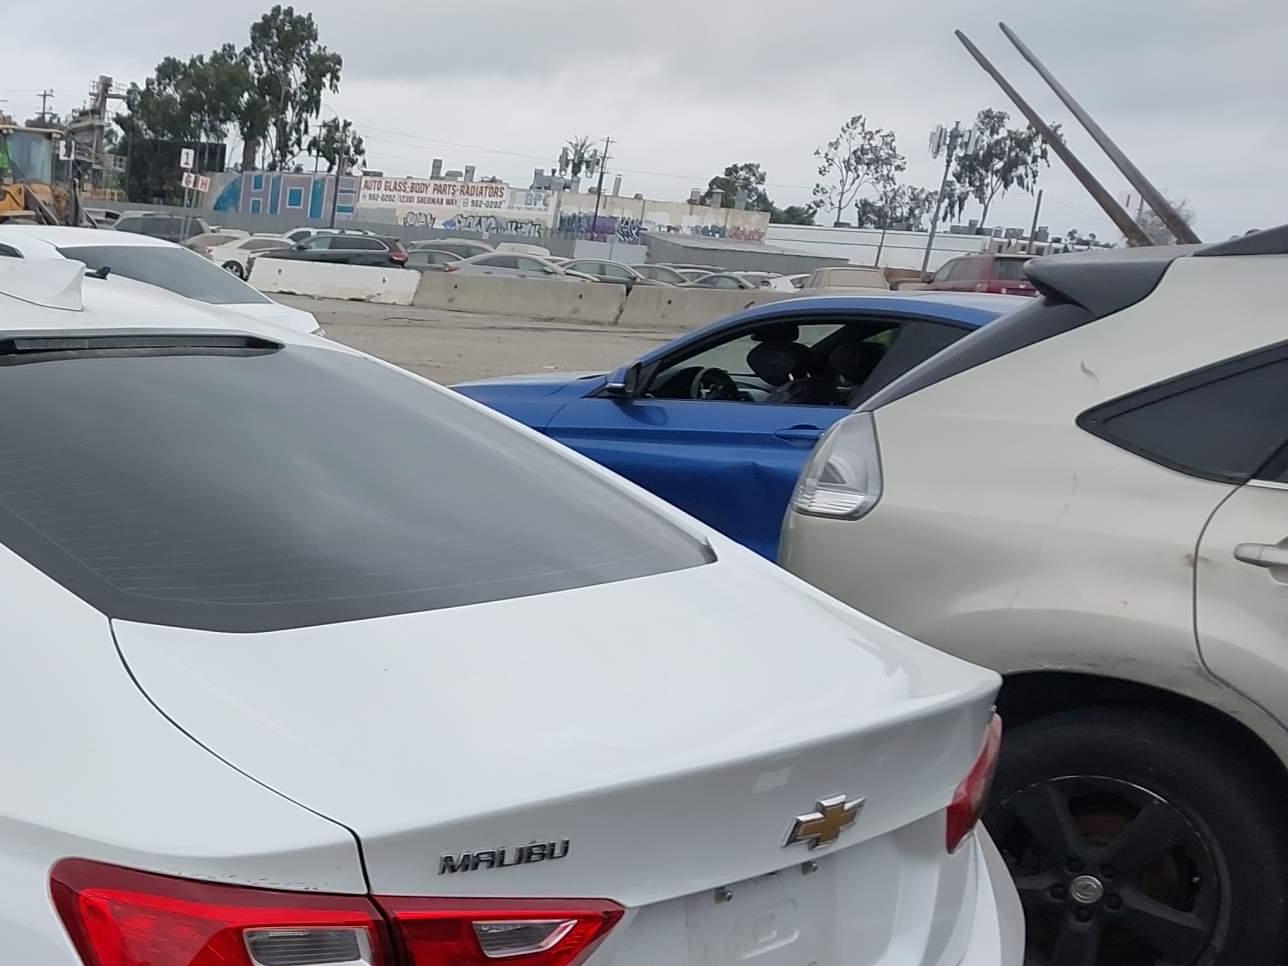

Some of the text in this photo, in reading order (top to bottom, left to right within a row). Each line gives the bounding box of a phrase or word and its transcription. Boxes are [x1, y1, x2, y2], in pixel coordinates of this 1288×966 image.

[183, 151, 191, 166] 1
[199, 178, 209, 191] H
[363, 180, 382, 191] AUTO
[438, 839, 570, 875] MALIBU
